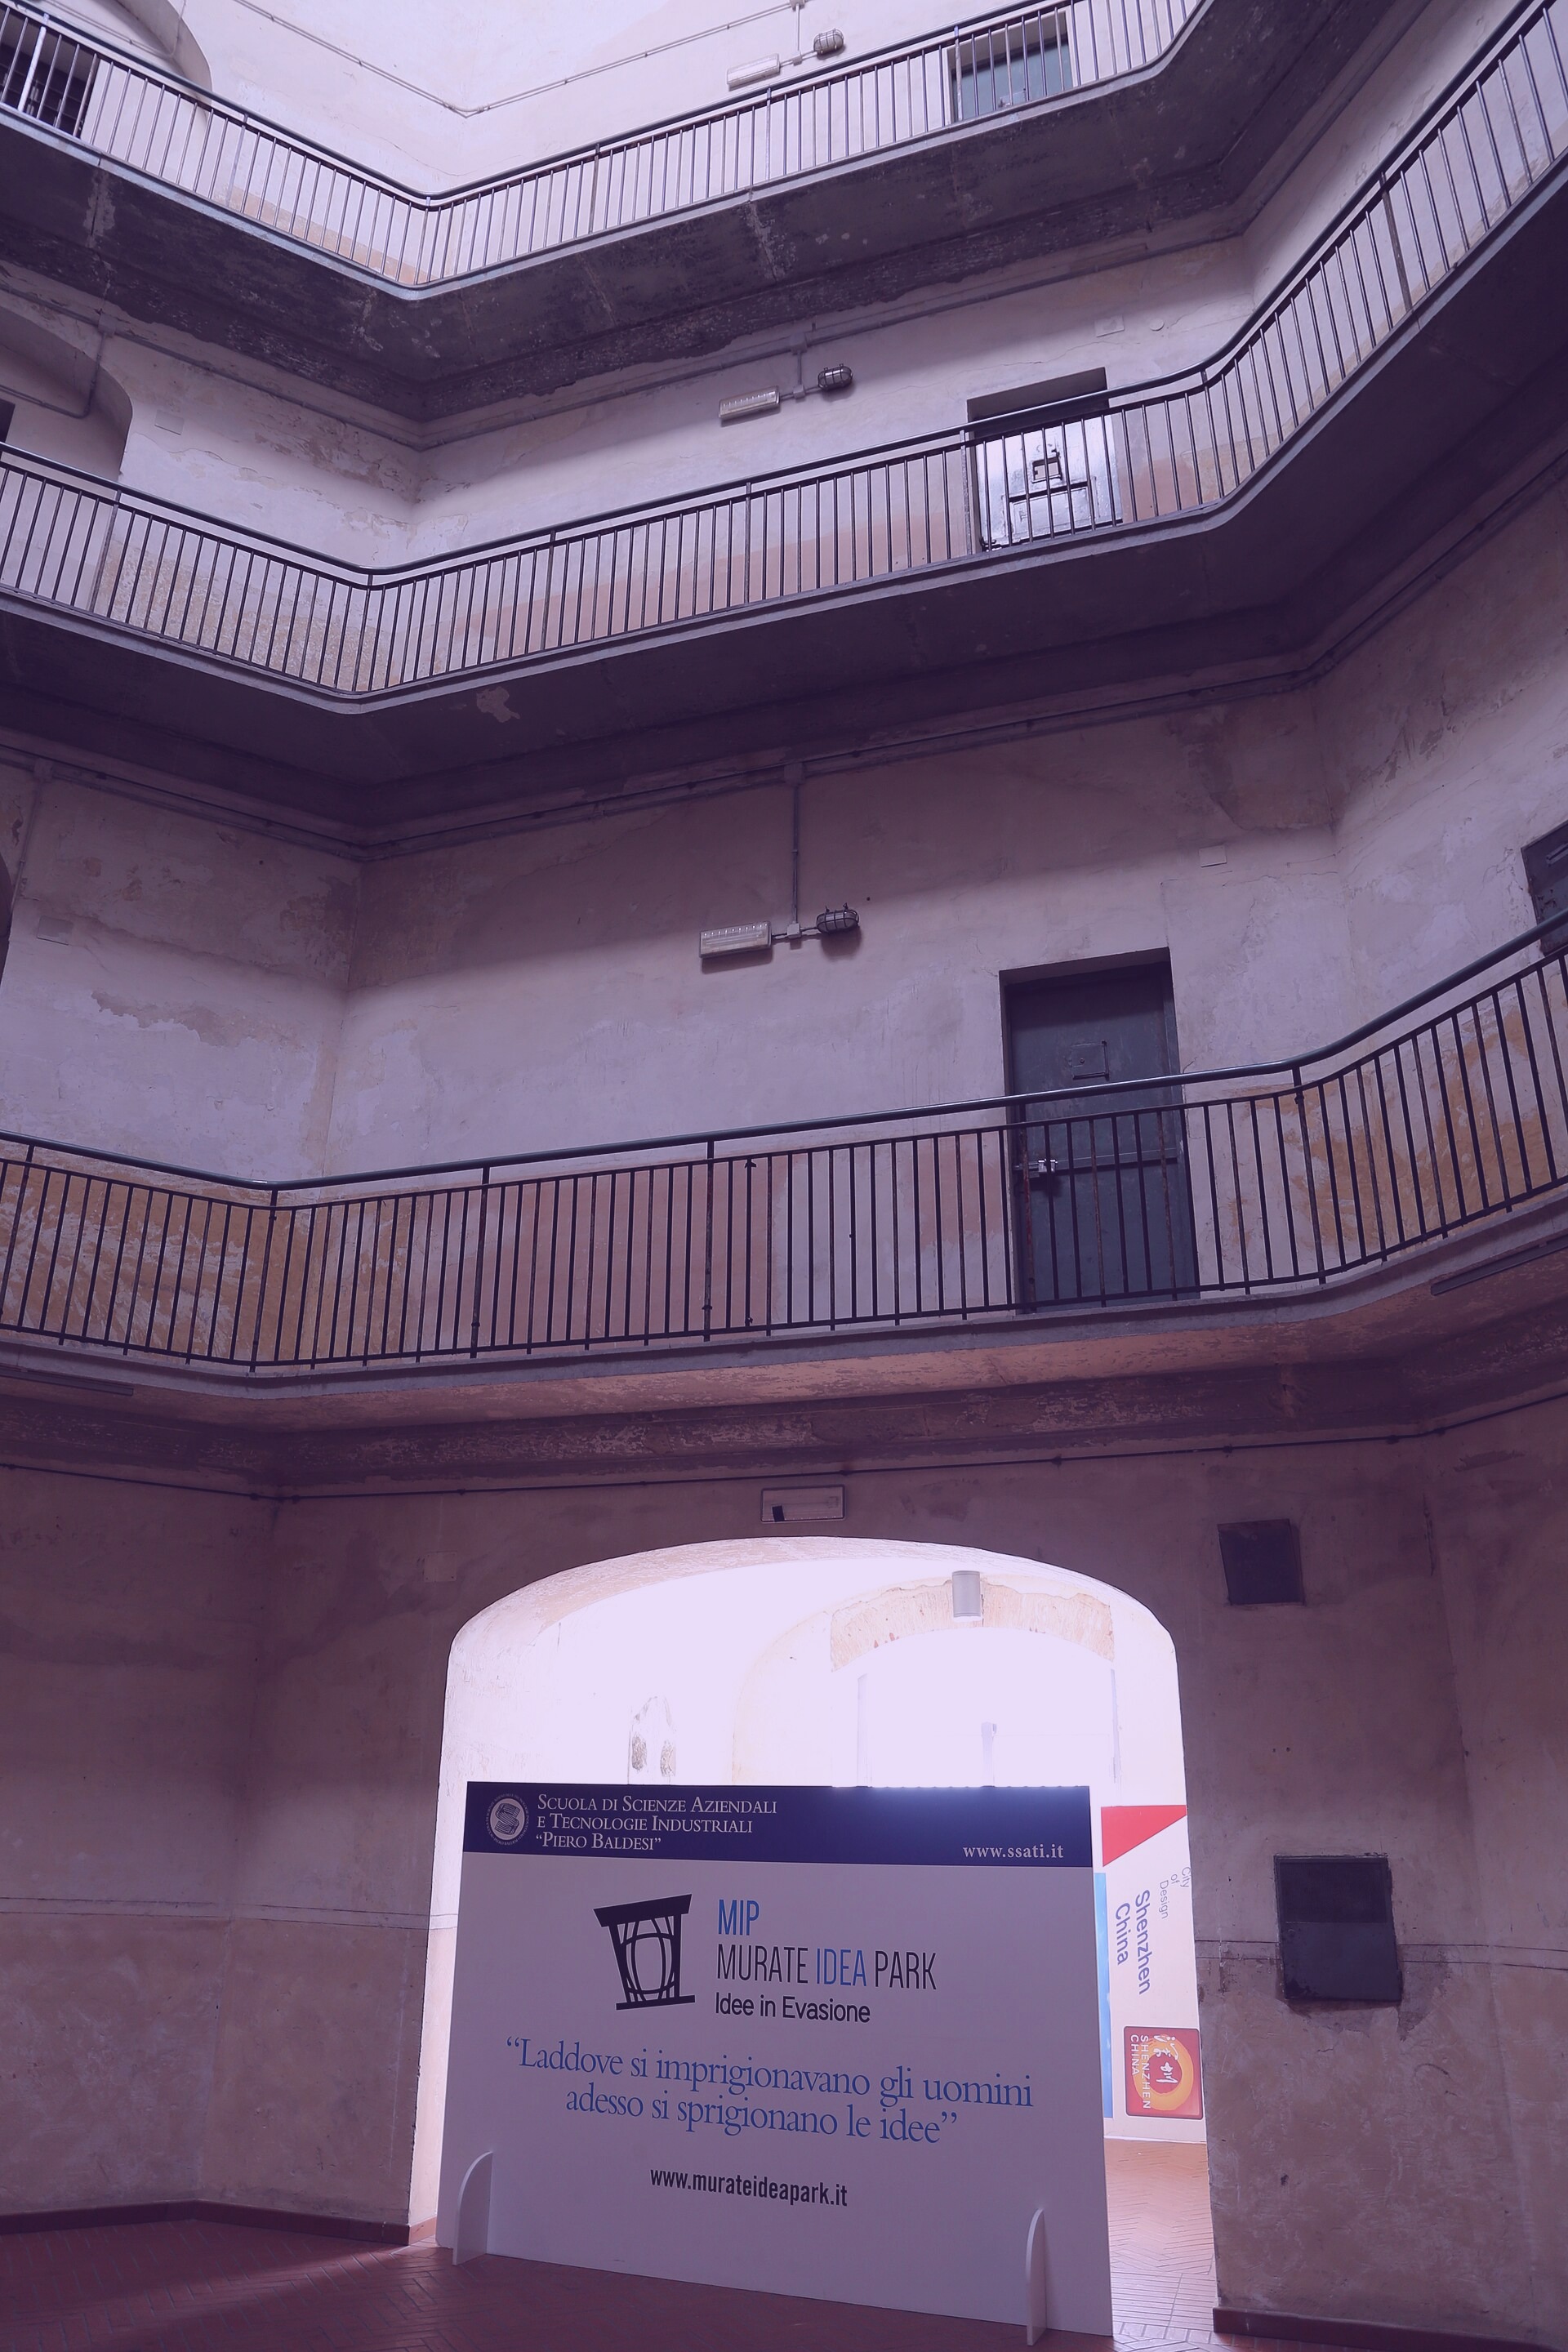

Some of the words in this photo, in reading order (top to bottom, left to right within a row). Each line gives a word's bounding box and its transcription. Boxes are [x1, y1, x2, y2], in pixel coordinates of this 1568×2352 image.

[537, 1793, 598, 1811] SCUOLA
[602, 1798, 618, 1811] DI
[622, 1795, 687, 1812] SCIENZE
[690, 1796, 777, 1814] AZIENDALI
[537, 1815, 546, 1829] E
[549, 1812, 648, 1831] TECNOLOGIE
[651, 1815, 753, 1833] INDUSTRIALI
[962, 1843, 1064, 1858] www.ssati.it
[1180, 1866, 1192, 1888] City
[718, 1899, 760, 1936] MIP
[1158, 1879, 1169, 1919] Design
[1116, 1902, 1131, 1966] China
[1135, 1889, 1152, 1995] Shenzhen
[717, 1943, 808, 1984] MURATE
[817, 1947, 867, 1987] IDEA
[875, 1950, 937, 1990] PARK
[715, 1992, 755, 2016] Idee
[760, 1994, 776, 2018] in
[782, 1995, 871, 2024] Evasione
[506, 2036, 623, 2075] “Laddove
[630, 2048, 648, 2078] si
[655, 2049, 871, 2096] imprigionavano
[880, 2065, 914, 2108] gli
[923, 2073, 1034, 2107] uomini
[1130, 2034, 1140, 2075] CHINA
[1140, 2034, 1152, 2109] SHENZHEN
[566, 2082, 644, 2118] adesso
[652, 2090, 670, 2120] si
[677, 2094, 838, 2136] sprigionano
[846, 2104, 871, 2138] le
[880, 2107, 958, 2144] idee”
[650, 2169, 848, 2207] www.murateideapark.it
